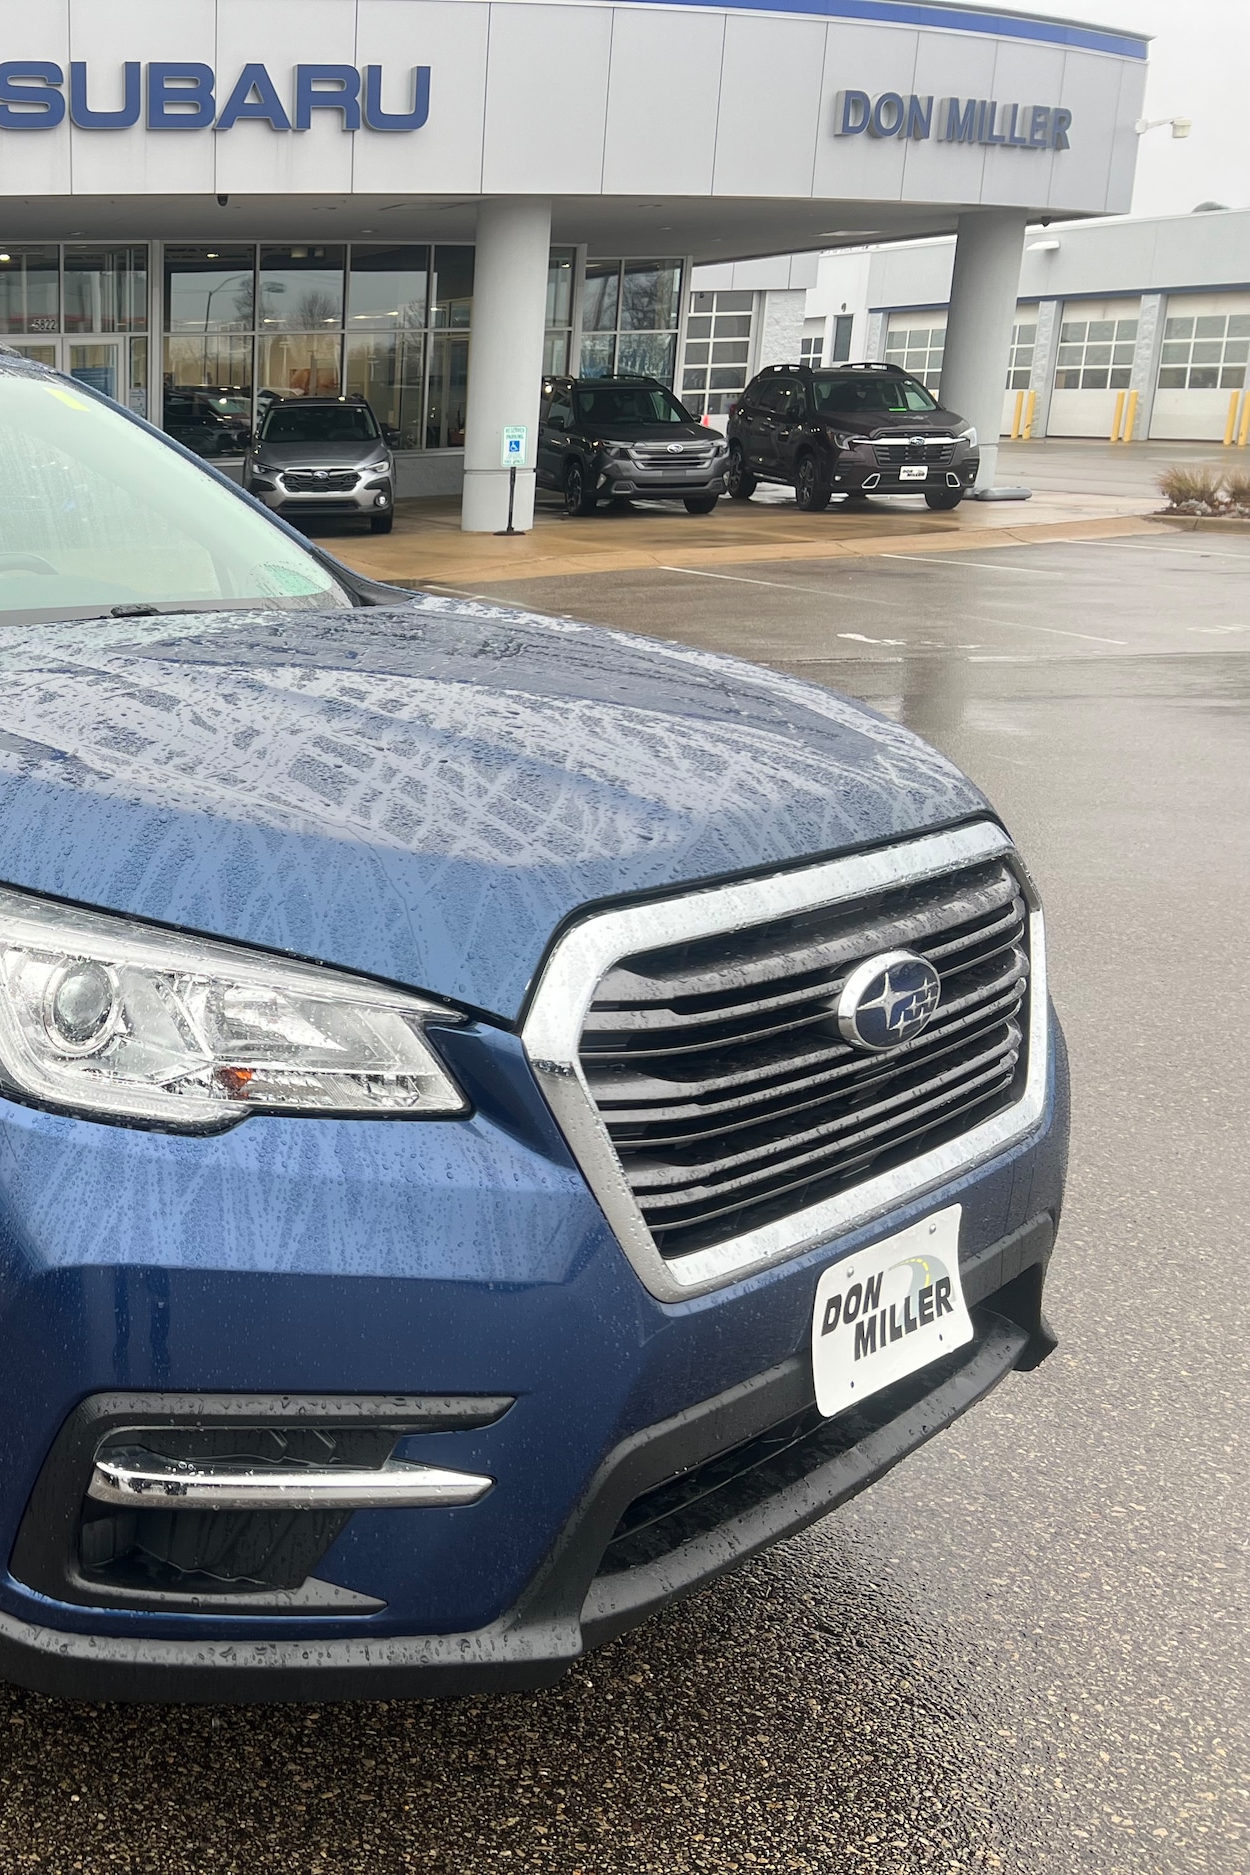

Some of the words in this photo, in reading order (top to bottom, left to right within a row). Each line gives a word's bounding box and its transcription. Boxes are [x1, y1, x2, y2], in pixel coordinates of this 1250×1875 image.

[835, 89, 934, 141] DON
[938, 97, 1072, 150] MILLER
[34, 319, 56, 330] 5822
[821, 1271, 884, 1337] DON
[854, 1276, 954, 1362] MILLER
